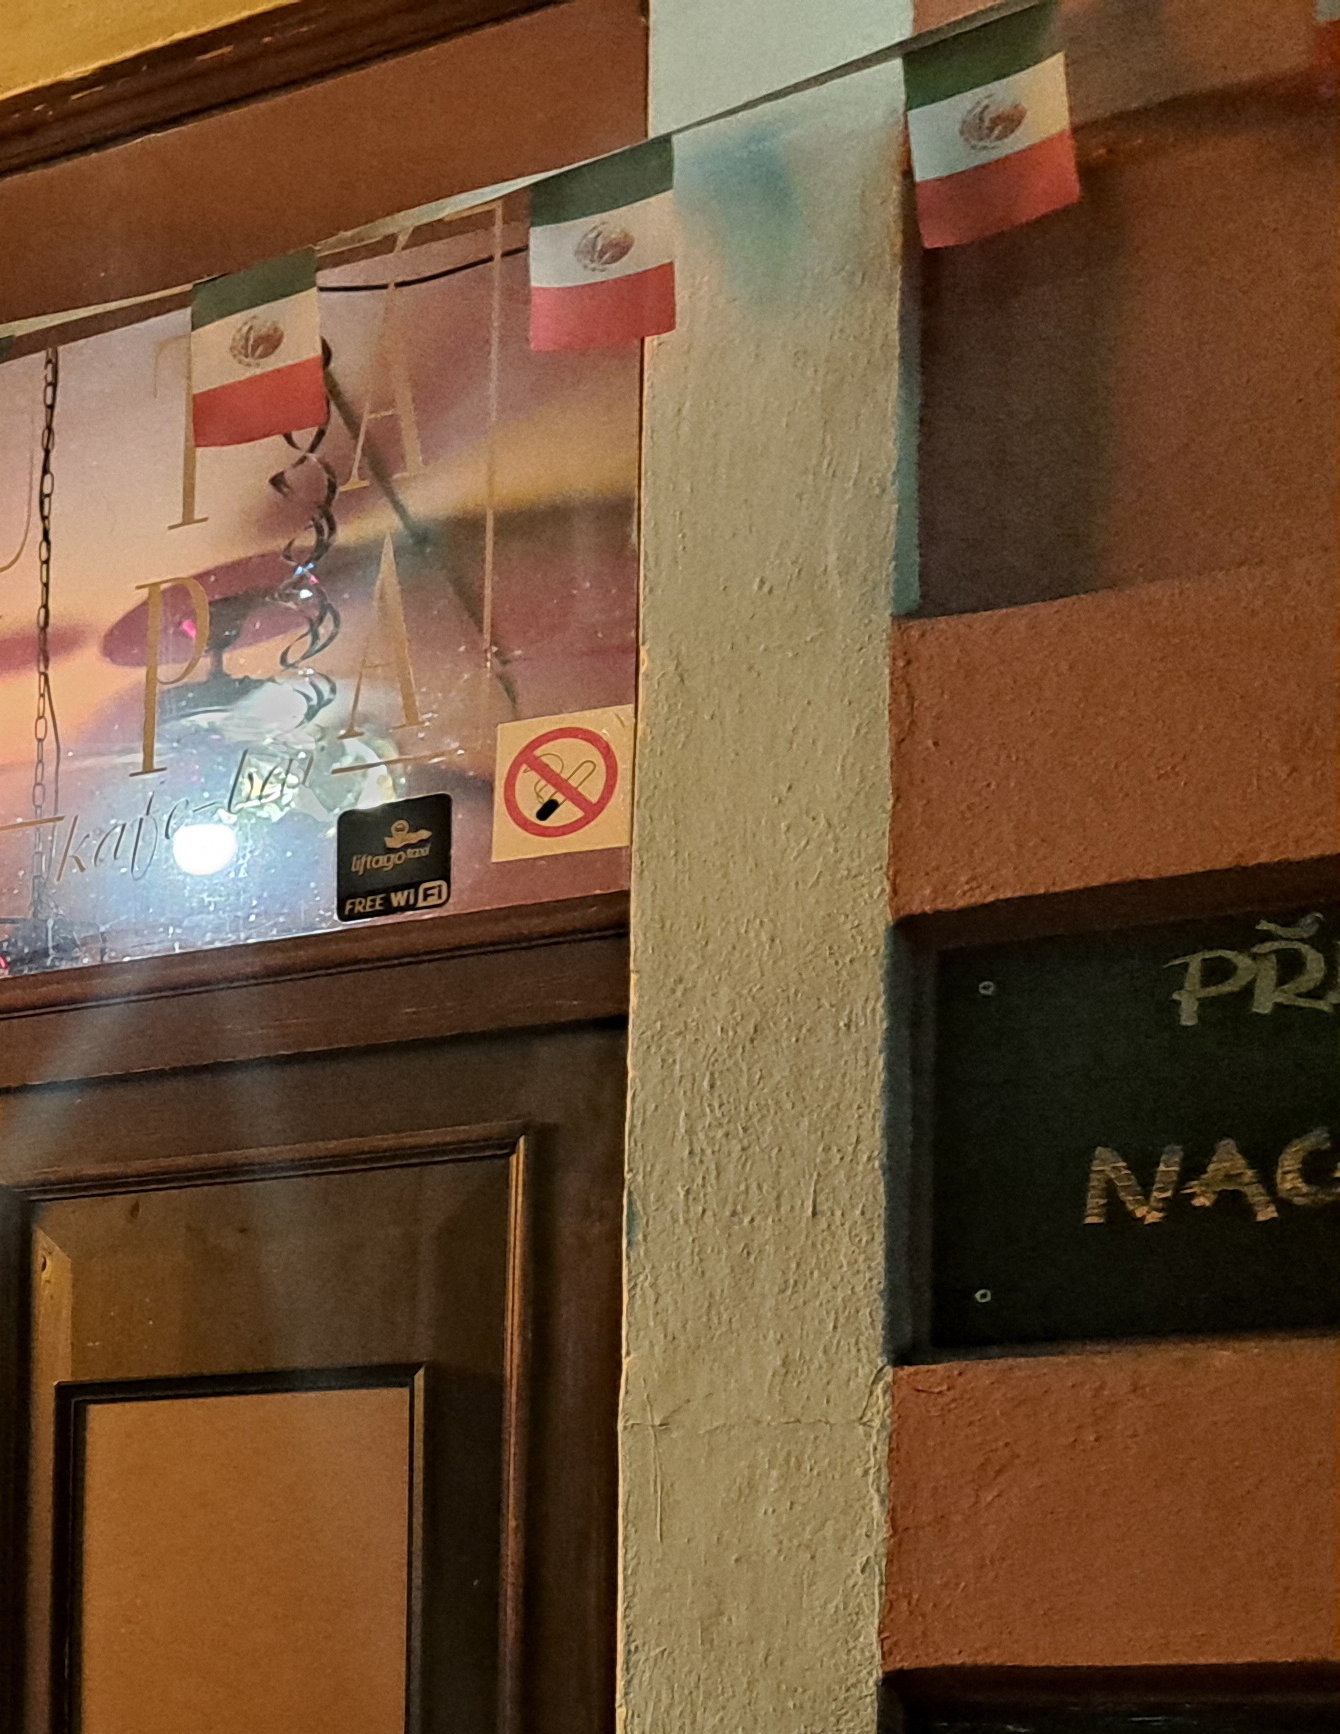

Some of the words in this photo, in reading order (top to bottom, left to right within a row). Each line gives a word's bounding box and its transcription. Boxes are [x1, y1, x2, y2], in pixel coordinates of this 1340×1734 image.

[351, 850, 406, 876] liftago
[345, 893, 386, 915] FREE
[1163, 912, 1339, 1026] PŘ
